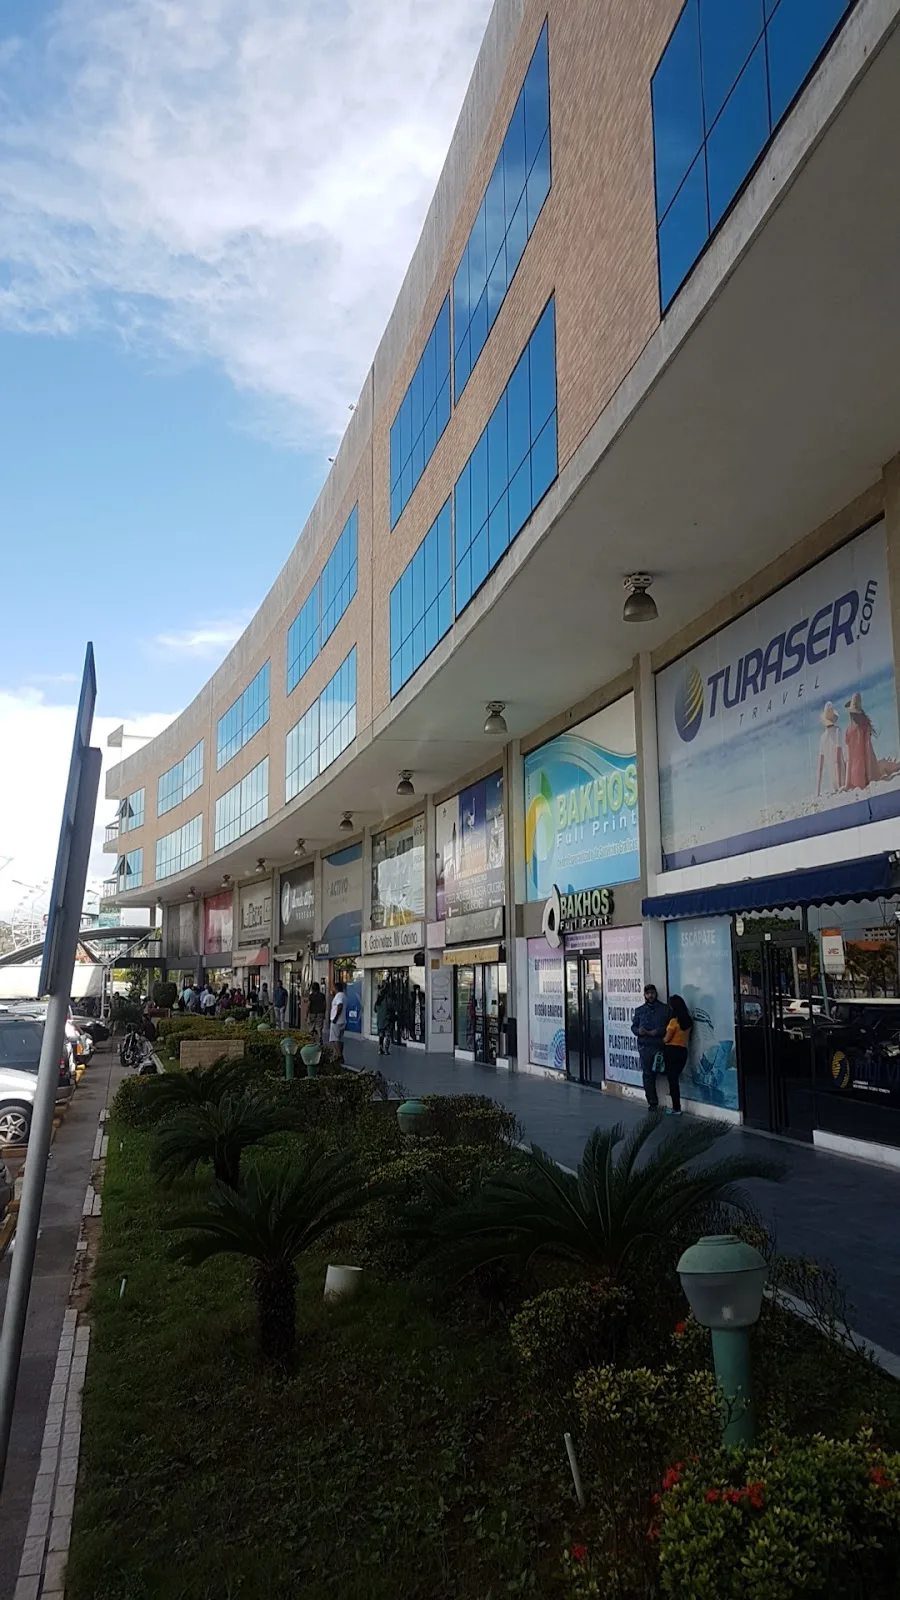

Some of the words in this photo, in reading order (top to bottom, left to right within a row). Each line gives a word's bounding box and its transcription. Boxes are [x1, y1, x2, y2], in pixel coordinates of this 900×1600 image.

[707, 590, 860, 719] TURASER
[738, 676, 821, 726] TRAVEL
[556, 764, 638, 831] BAKHOS
[556, 826, 584, 849] Full
[592, 809, 637, 837] Print
[560, 889, 610, 920] BAKHOS
[560, 918, 577, 931] Full
[581, 915, 608, 928] Print
[607, 952, 637, 968] FOTOCOPIAS
[608, 978, 641, 993] IMPRESIONES
[609, 1034, 639, 1052] PLASTIFICA
[609, 1052, 643, 1072] ENCUADERNA
